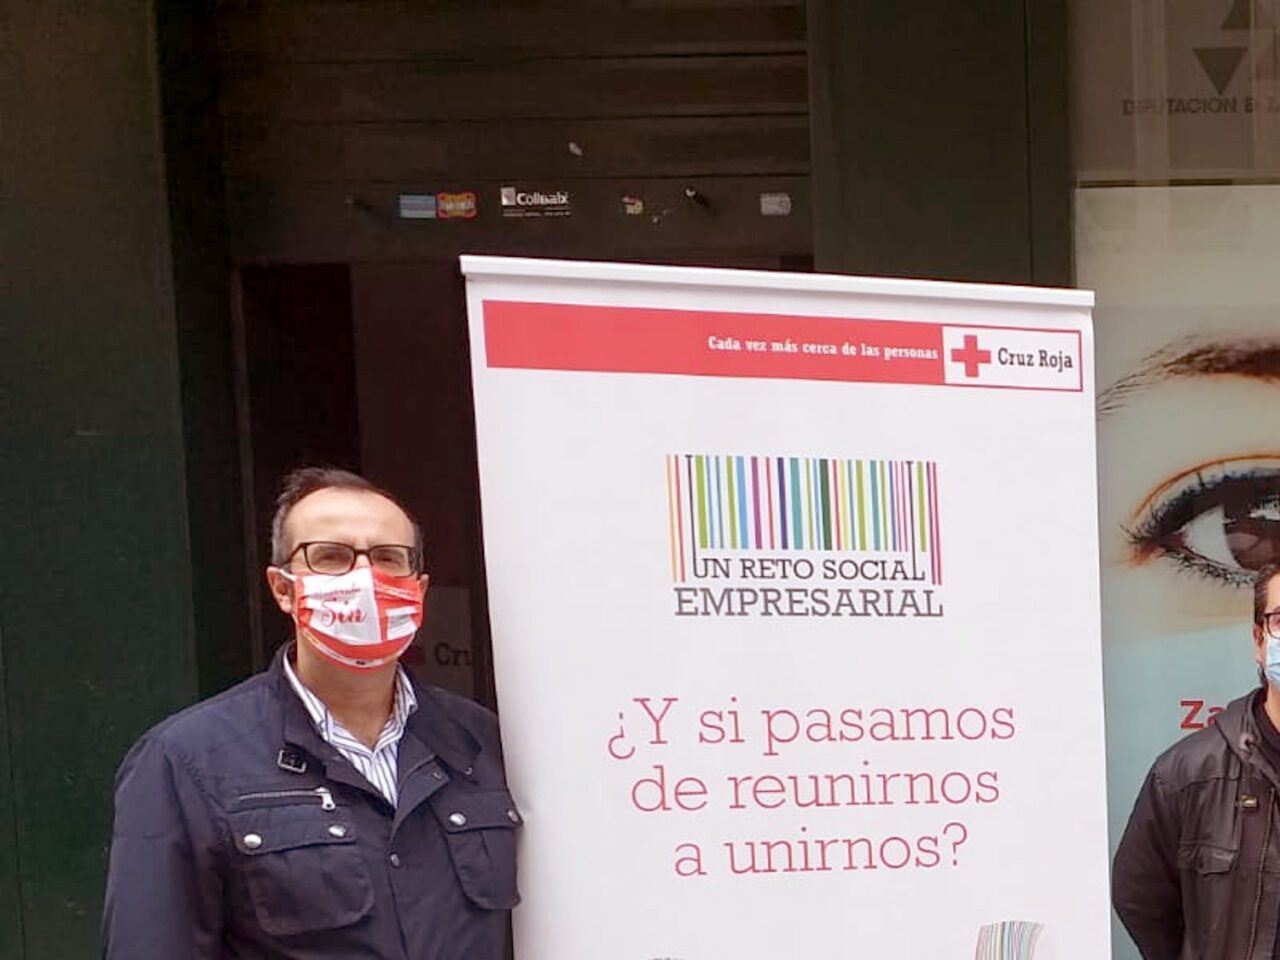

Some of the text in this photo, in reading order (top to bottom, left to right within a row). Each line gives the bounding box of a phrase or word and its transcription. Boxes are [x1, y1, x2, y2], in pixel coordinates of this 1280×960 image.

[708, 336, 939, 361] Cada vez más cerca de las personas
[997, 347, 1074, 373] Cruz Roja
[740, 558, 814, 580] RETO
[823, 559, 926, 581] SOCIAL
[673, 587, 944, 618] EMPRESARIAL
[607, 696, 1016, 760] ¿Y si pasamos
[631, 760, 1001, 812] de reunirnos
[675, 821, 968, 877] a unirnos?
